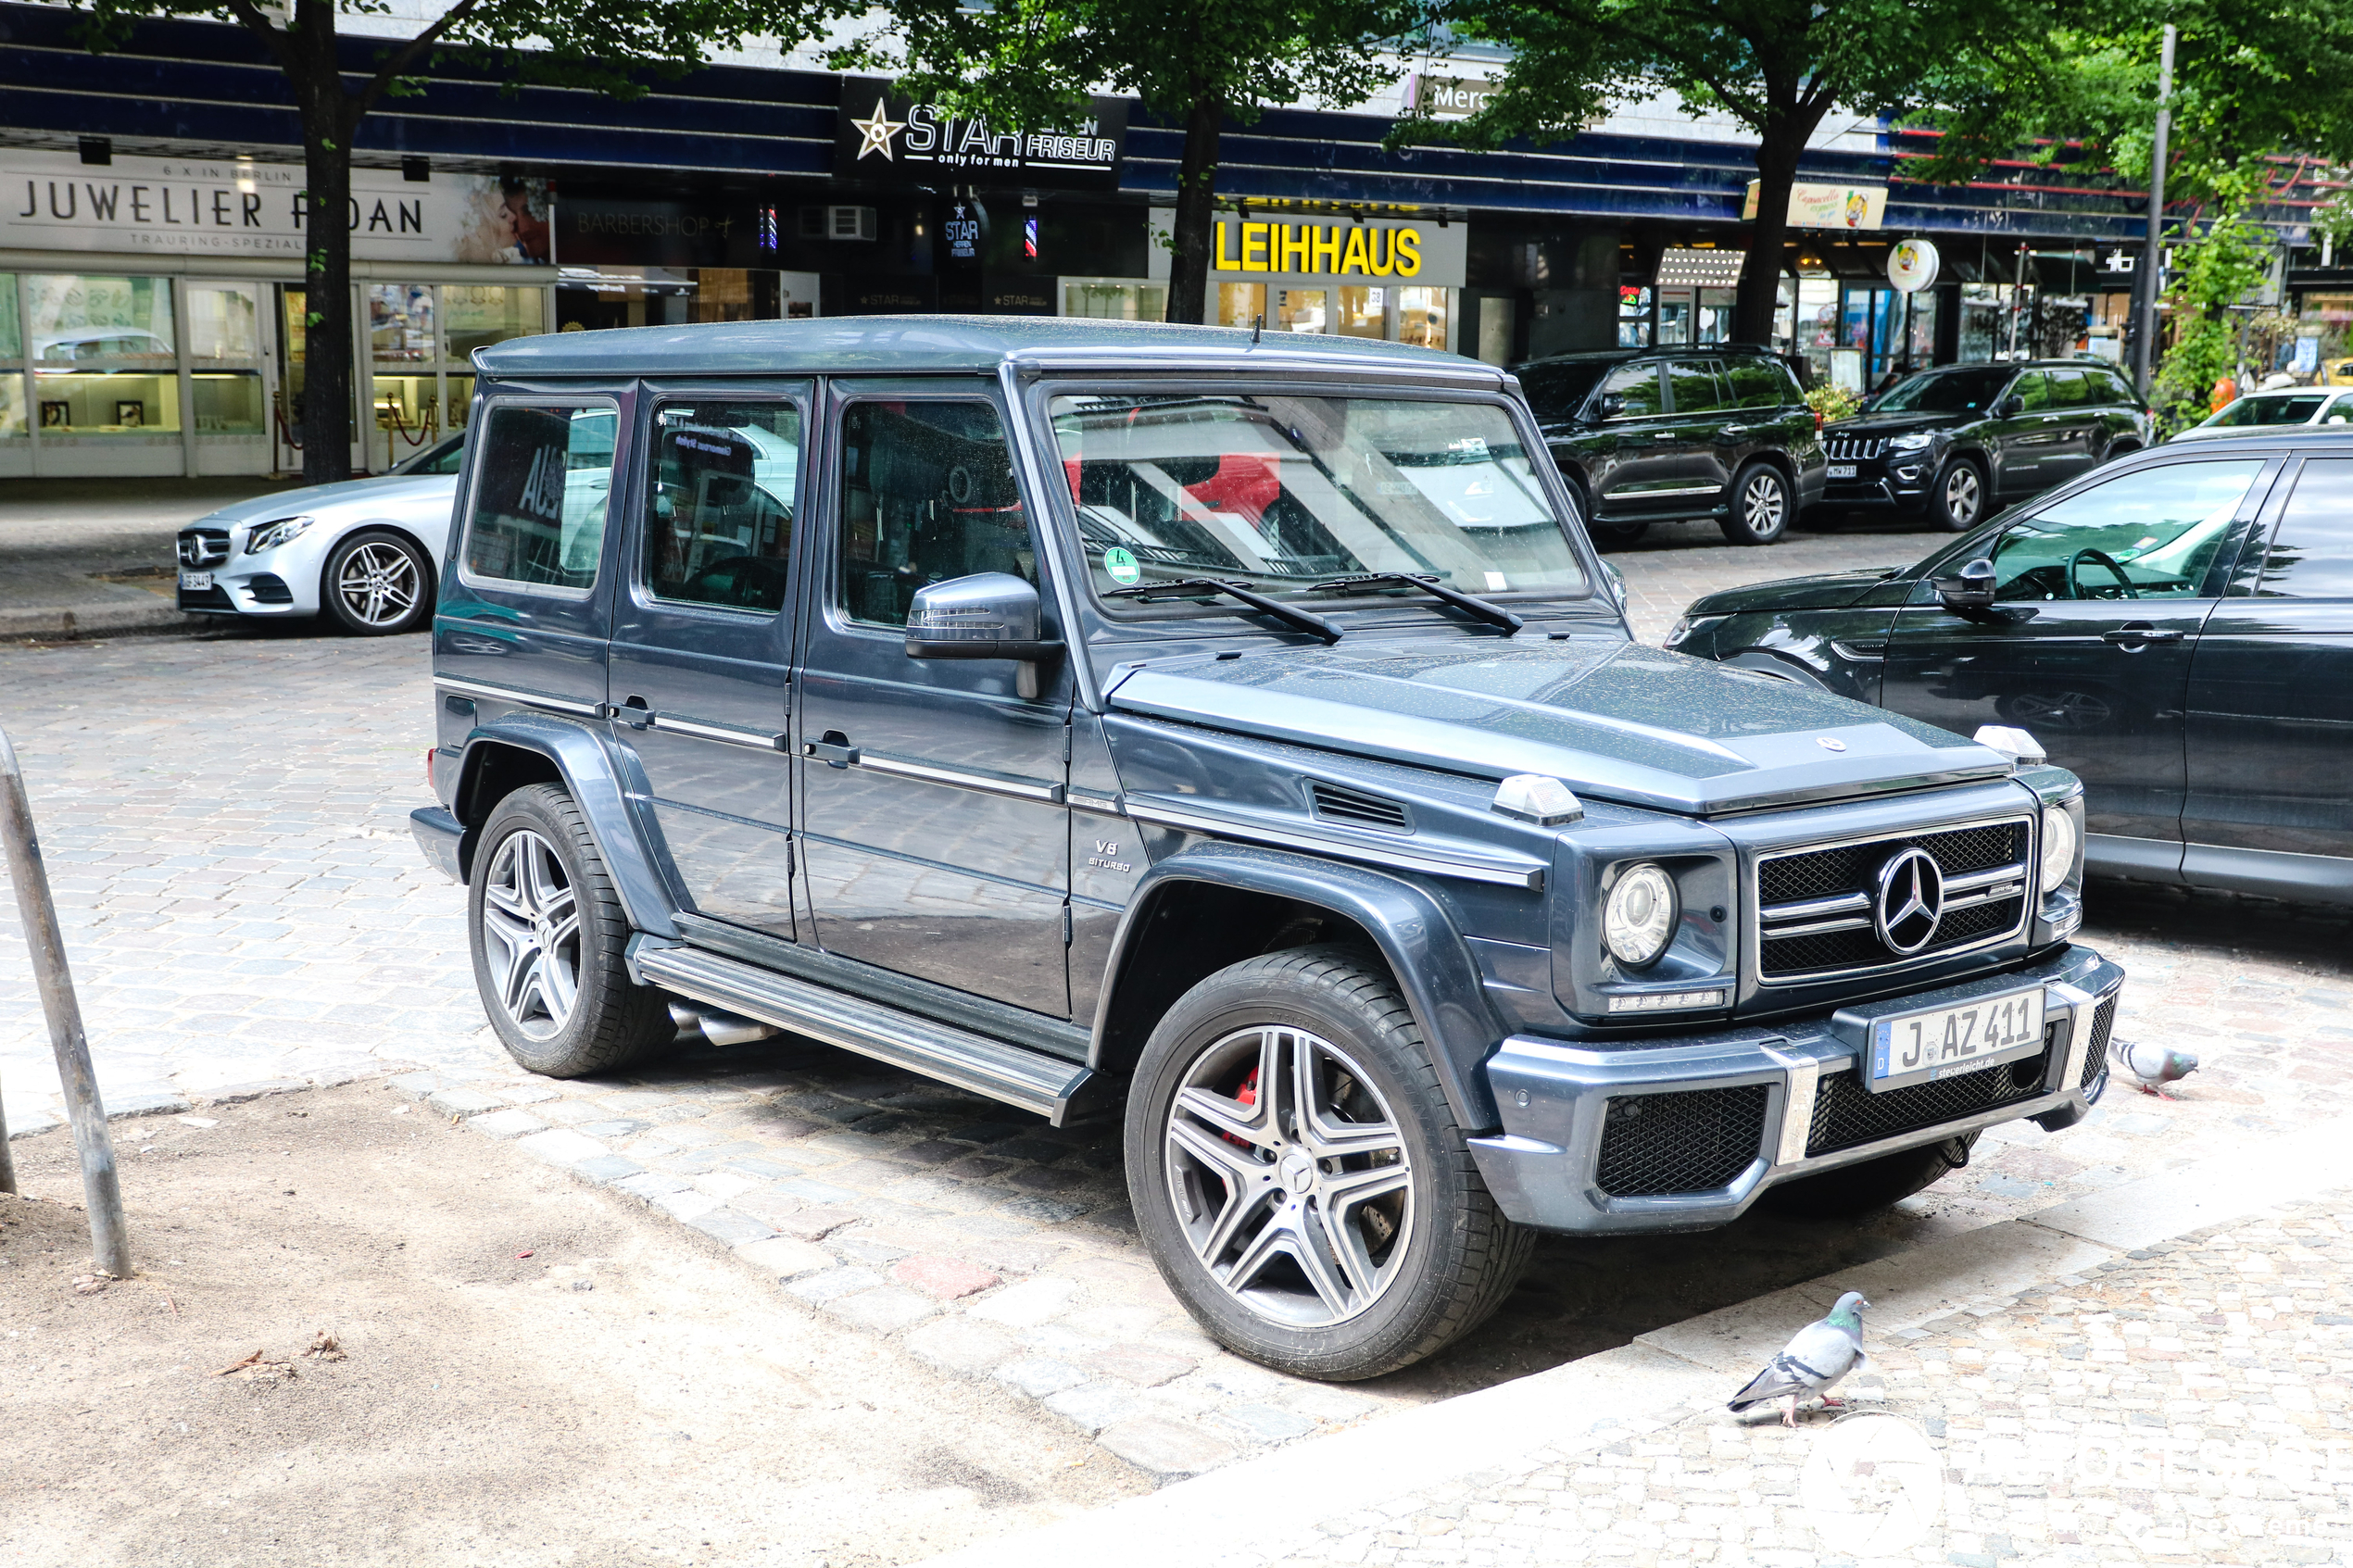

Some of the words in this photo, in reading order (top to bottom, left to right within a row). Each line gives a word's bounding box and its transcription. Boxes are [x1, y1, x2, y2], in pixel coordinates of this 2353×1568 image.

[1026, 134, 1116, 162] FRISEUR
[938, 154, 967, 168] only
[970, 154, 990, 167] for
[993, 157, 1019, 168] men
[163, 166, 171, 176] 6
[182, 168, 191, 176] X
[202, 169, 220, 178] IN
[231, 169, 291, 182] BERLIN
[19, 181, 261, 228] JUWELIER
[578, 212, 710, 237] BARBERSHOP
[945, 220, 979, 241] STAR
[1215, 221, 1422, 277] LEIHHAUS
[1002, 295, 1028, 306] STAR
[1095, 839, 1118, 856] V8
[1088, 857, 1131, 872] BITURBO
[1902, 1022, 1922, 1068] J
[1941, 1010, 1979, 1060] AZ
[1984, 997, 2032, 1048] 411
[1877, 1057, 1885, 1071] D
[1938, 1057, 1995, 1079] steuerleicht.de
